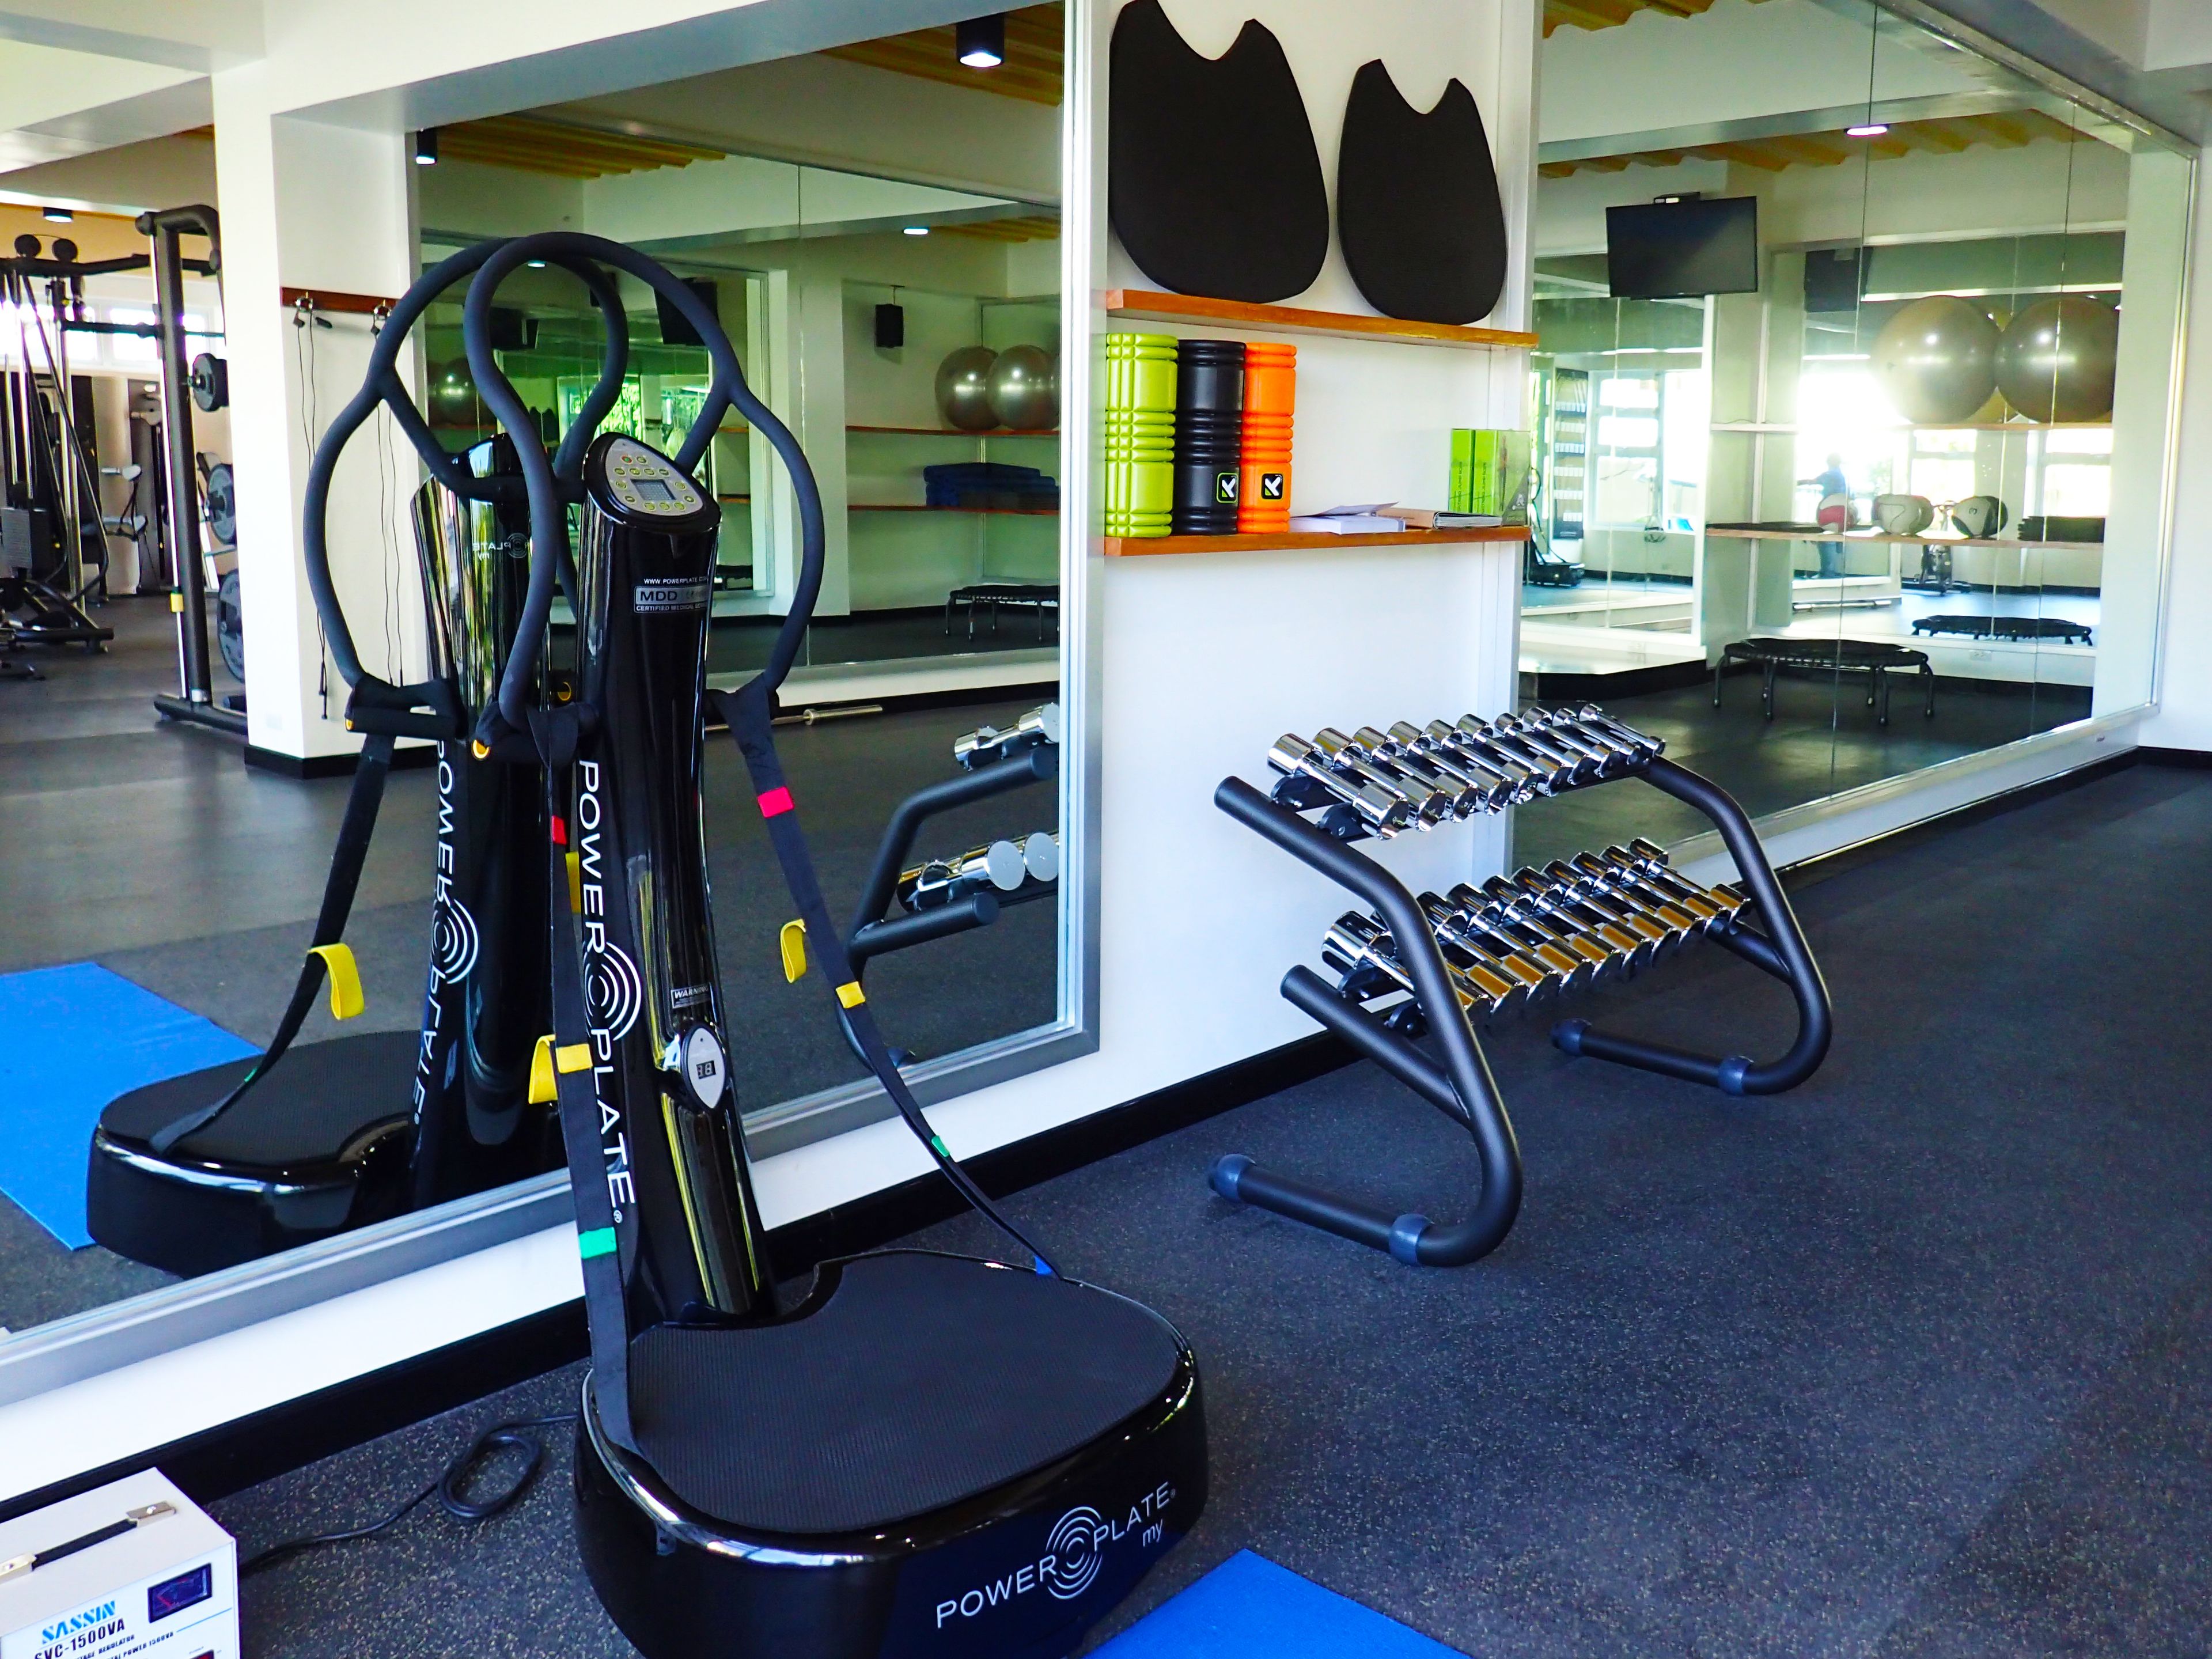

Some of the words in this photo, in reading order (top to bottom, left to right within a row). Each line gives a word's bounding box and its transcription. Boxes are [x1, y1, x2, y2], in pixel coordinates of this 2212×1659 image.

[640, 591, 677, 601] MDD
[579, 759, 605, 954] POWER
[675, 986, 709, 999] WARNING
[1142, 1519, 1164, 1548] my
[936, 1555, 1058, 1629] POWER
[42, 1600, 115, 1645] SASSIN
